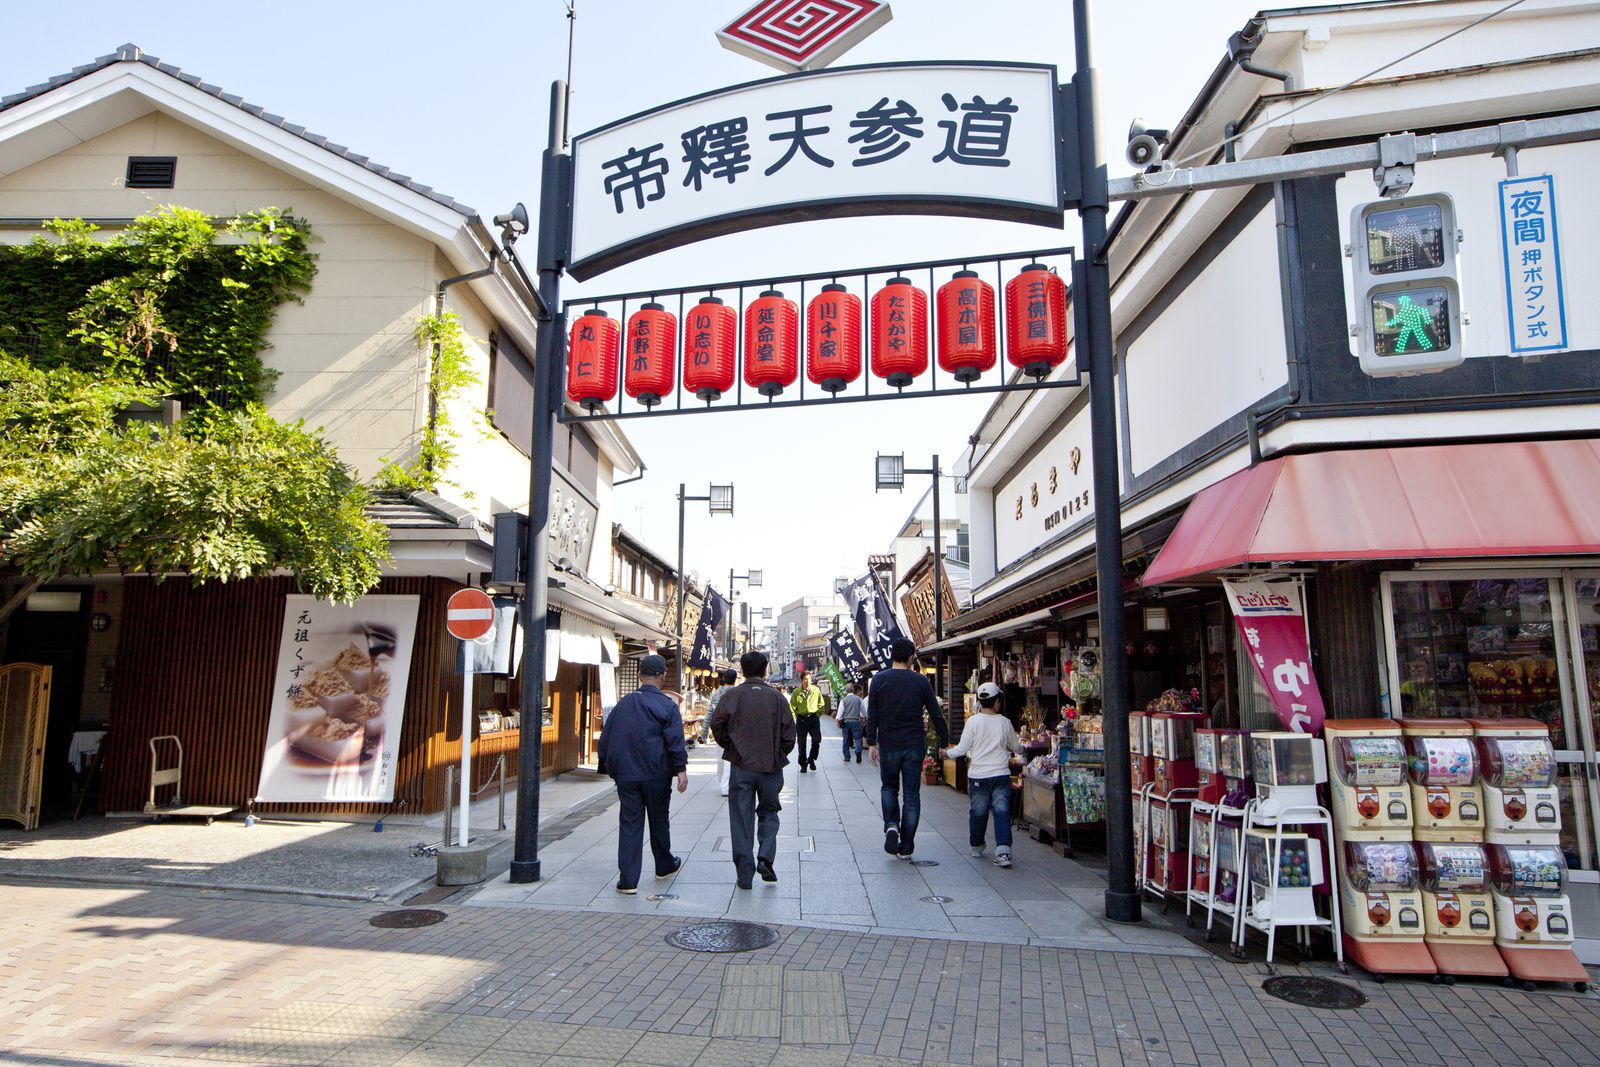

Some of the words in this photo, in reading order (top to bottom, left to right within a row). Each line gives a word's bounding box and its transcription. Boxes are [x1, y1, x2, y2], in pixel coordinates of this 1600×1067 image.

[601, 92, 1019, 214] 帝釋天参道
[1510, 190, 1546, 246] 夜間
[1521, 248, 1548, 339] 押ボタン式
[694, 315, 711, 366] い志い
[757, 307, 775, 361] 延命堂
[819, 302, 837, 358] 川千家
[888, 295, 906, 351] たなかや
[286, 610, 312, 699] 元祖くず餅
